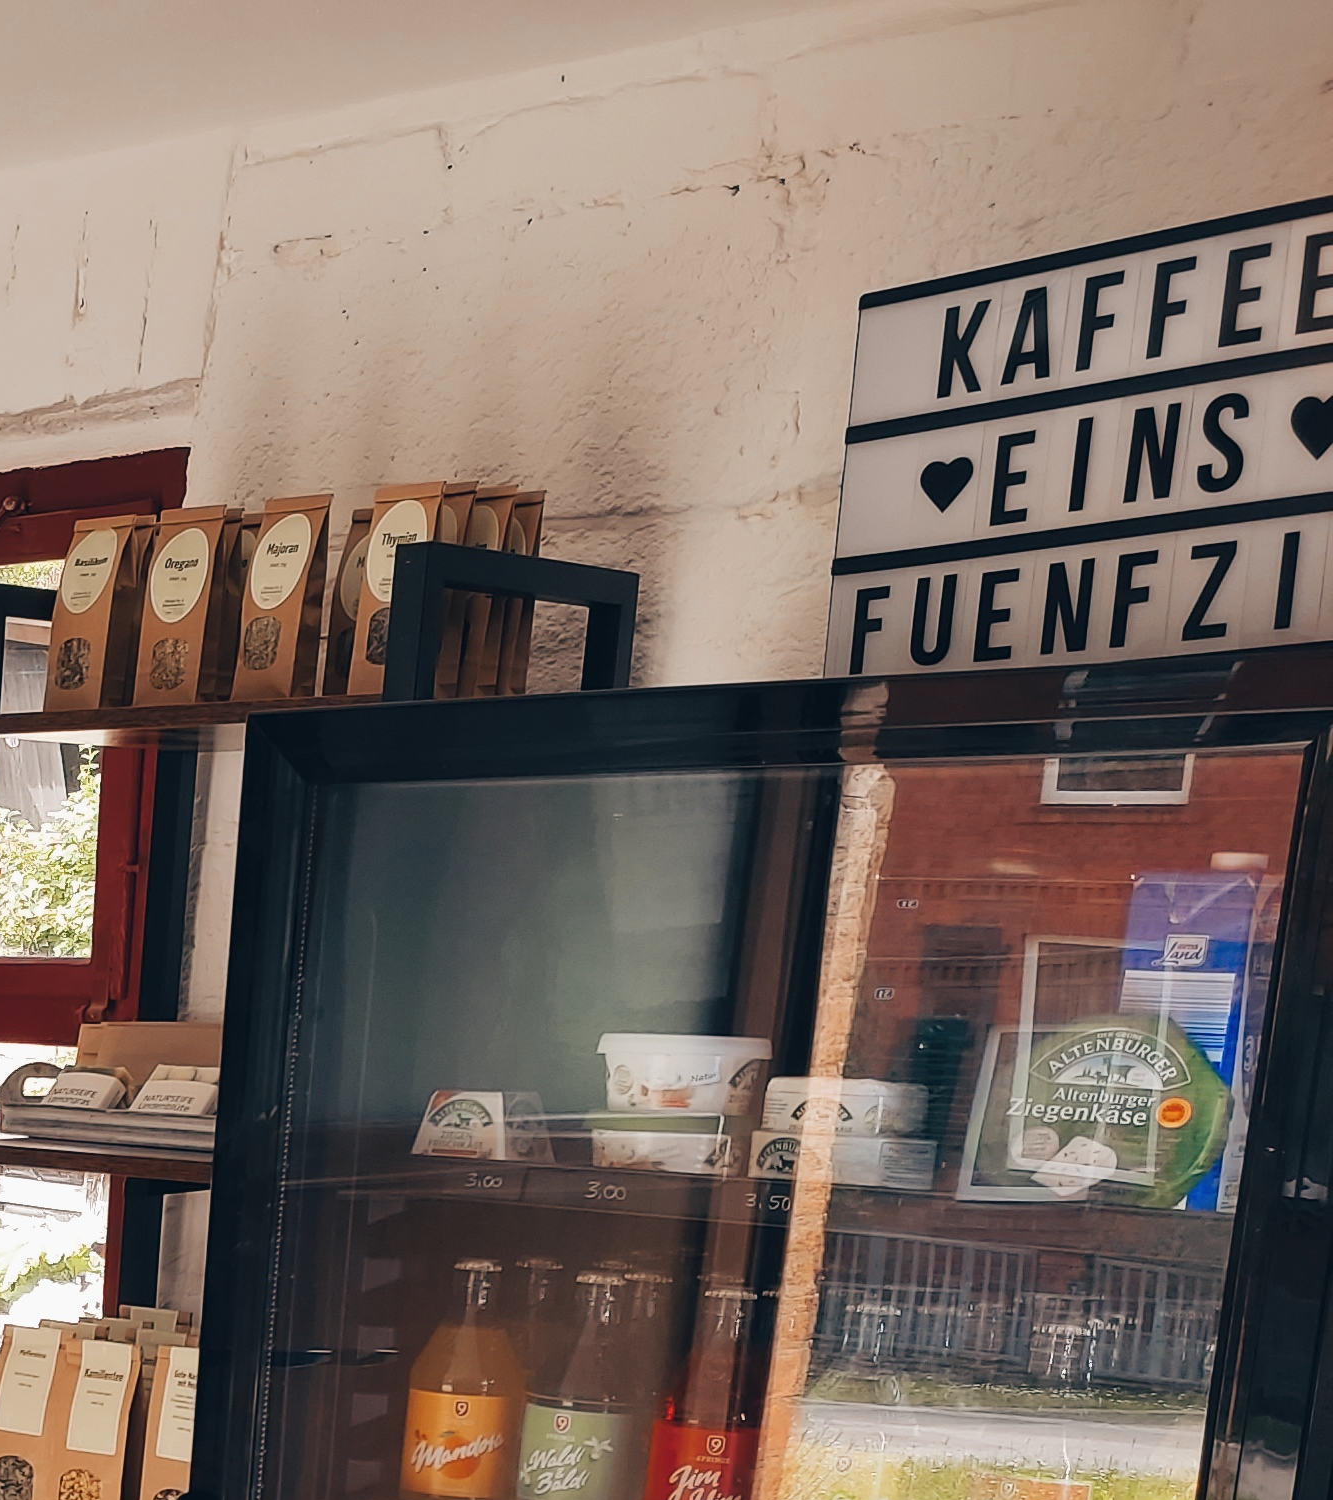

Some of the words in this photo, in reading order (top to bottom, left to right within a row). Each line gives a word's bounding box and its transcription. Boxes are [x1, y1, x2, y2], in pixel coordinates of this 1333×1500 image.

[936, 231, 1333, 399] KAFFEE
[989, 392, 1250, 527] EINS
[266, 541, 299, 558] Majoran
[381, 530, 418, 548] Thymian
[164, 556, 199, 573] Oregano
[1047, 1037, 1179, 1082] ALTENBURGER
[1052, 1086, 1157, 1109] Altenburger
[1006, 1097, 1147, 1127] Ziegenkäse
[584, 1180, 627, 1200] 3,00
